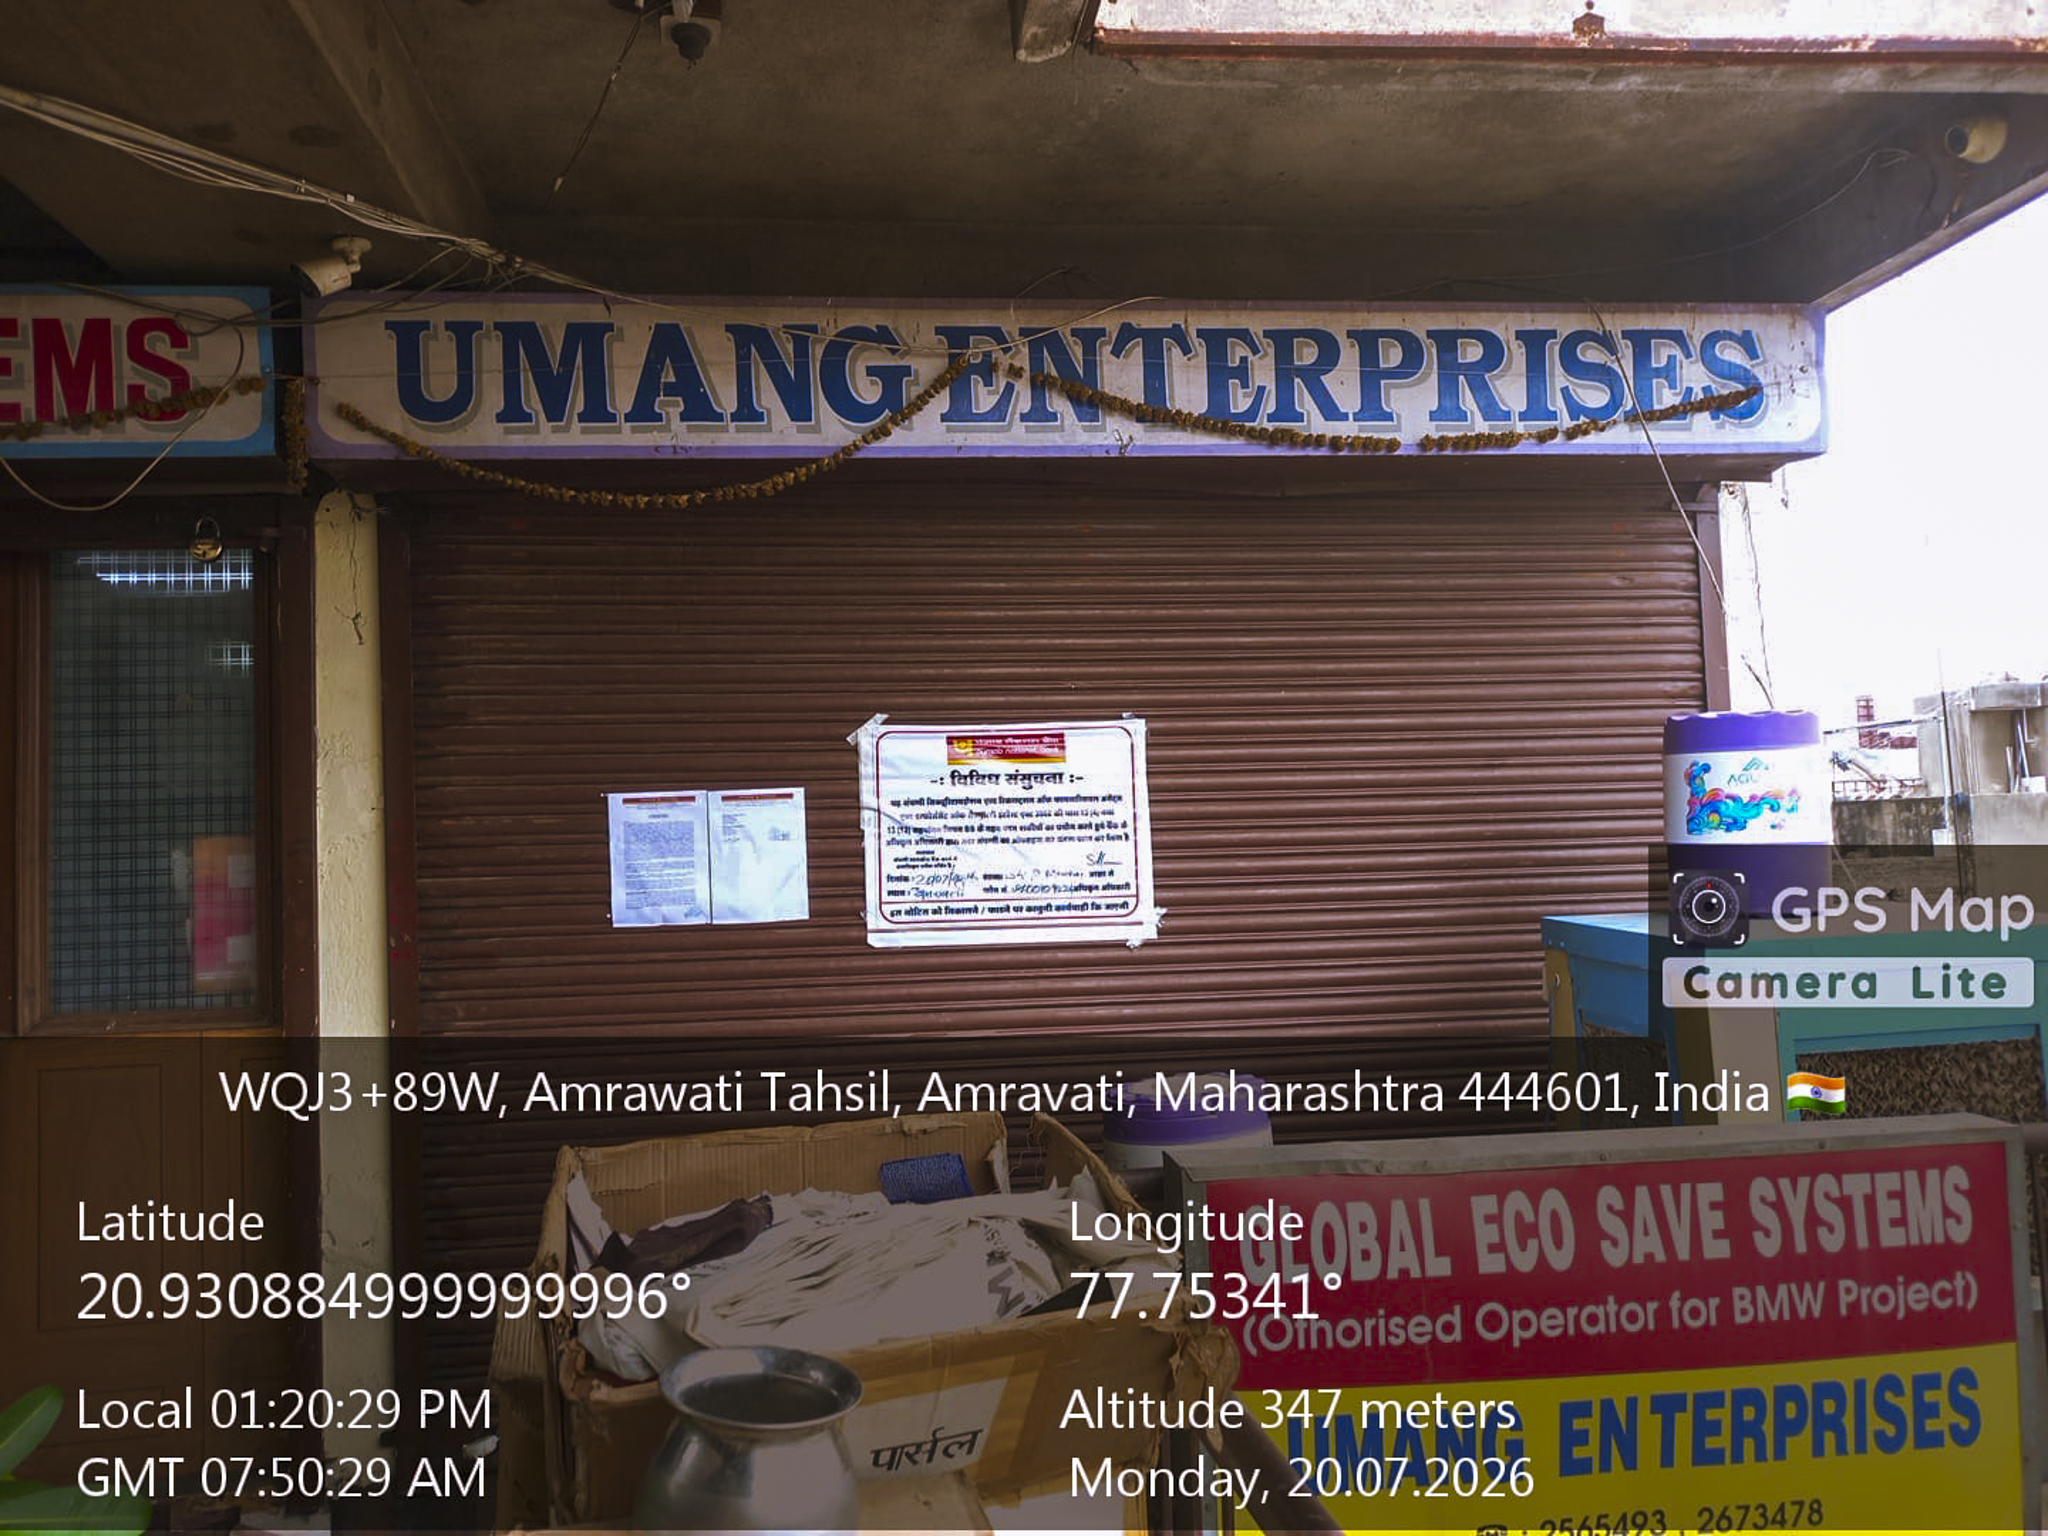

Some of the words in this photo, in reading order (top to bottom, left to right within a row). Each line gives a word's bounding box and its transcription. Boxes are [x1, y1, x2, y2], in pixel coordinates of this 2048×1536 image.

[384, 319, 914, 425] UMANG
[935, 321, 1766, 426] ENTERPRISES
[1239, 1199, 1453, 1286] GLOBAL
[1470, 1187, 1576, 1275] ECO
[1596, 1181, 1732, 1269] SAVE
[1748, 1165, 1974, 1258] SYSTEMS
[1475, 1295, 1658, 1348] Operator
[1669, 1290, 1720, 1329] for
[1731, 1280, 1826, 1325] BMW
[1837, 1270, 1979, 1321] Project)
[869, 1426, 984, 1472] पार्सल
[1287, 1402, 1525, 1494] UMANG
[1558, 1366, 1982, 1478] ENTERPRISES
[1697, 1499, 1824, 1535] 2673478
